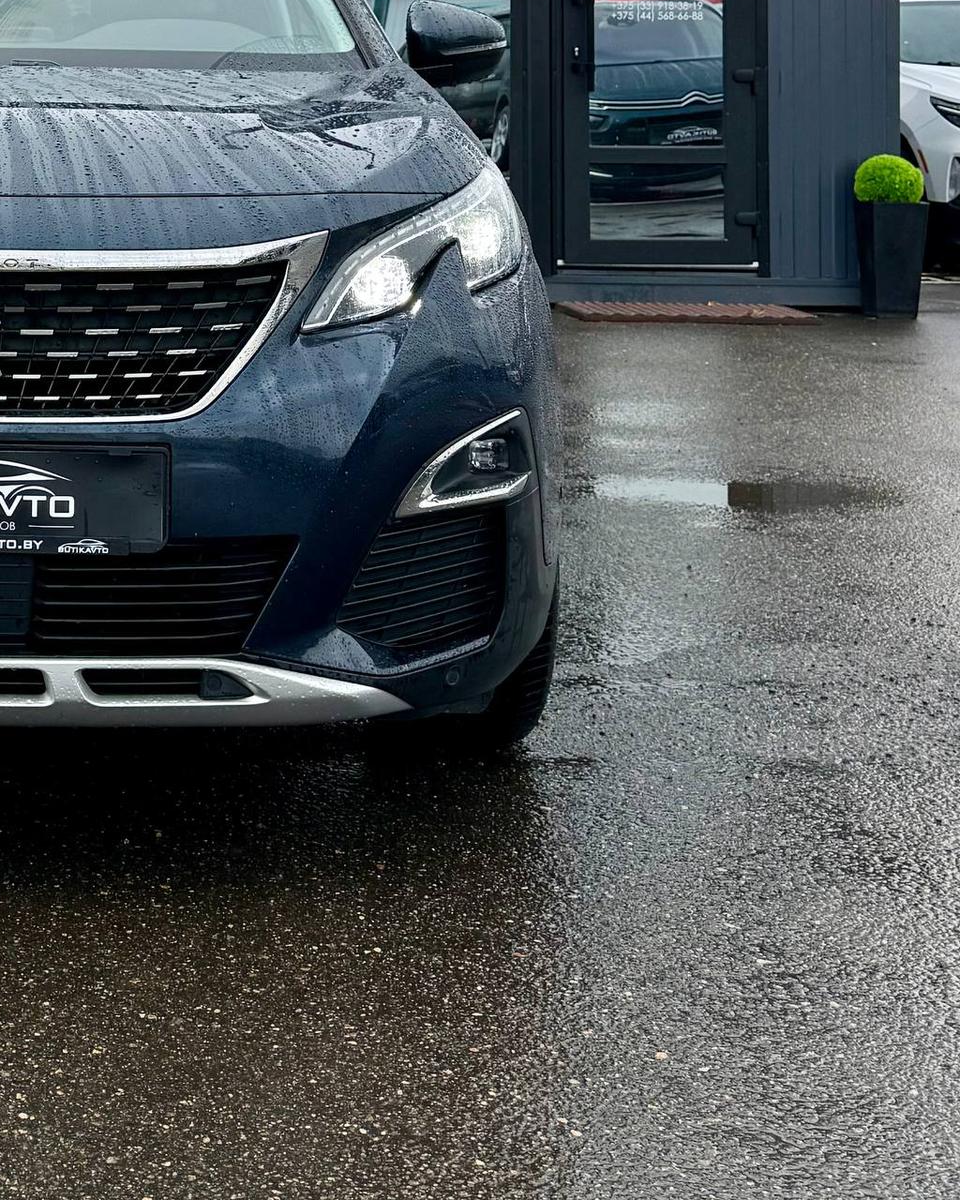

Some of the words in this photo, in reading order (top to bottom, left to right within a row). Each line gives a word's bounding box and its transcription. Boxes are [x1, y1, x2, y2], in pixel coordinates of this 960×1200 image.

[612, 11, 634, 20] +375
[637, 11, 655, 22] (44)
[657, 11, 704, 21] 568-66-88
[57, 545, 109, 555] BUTIKAVTO
